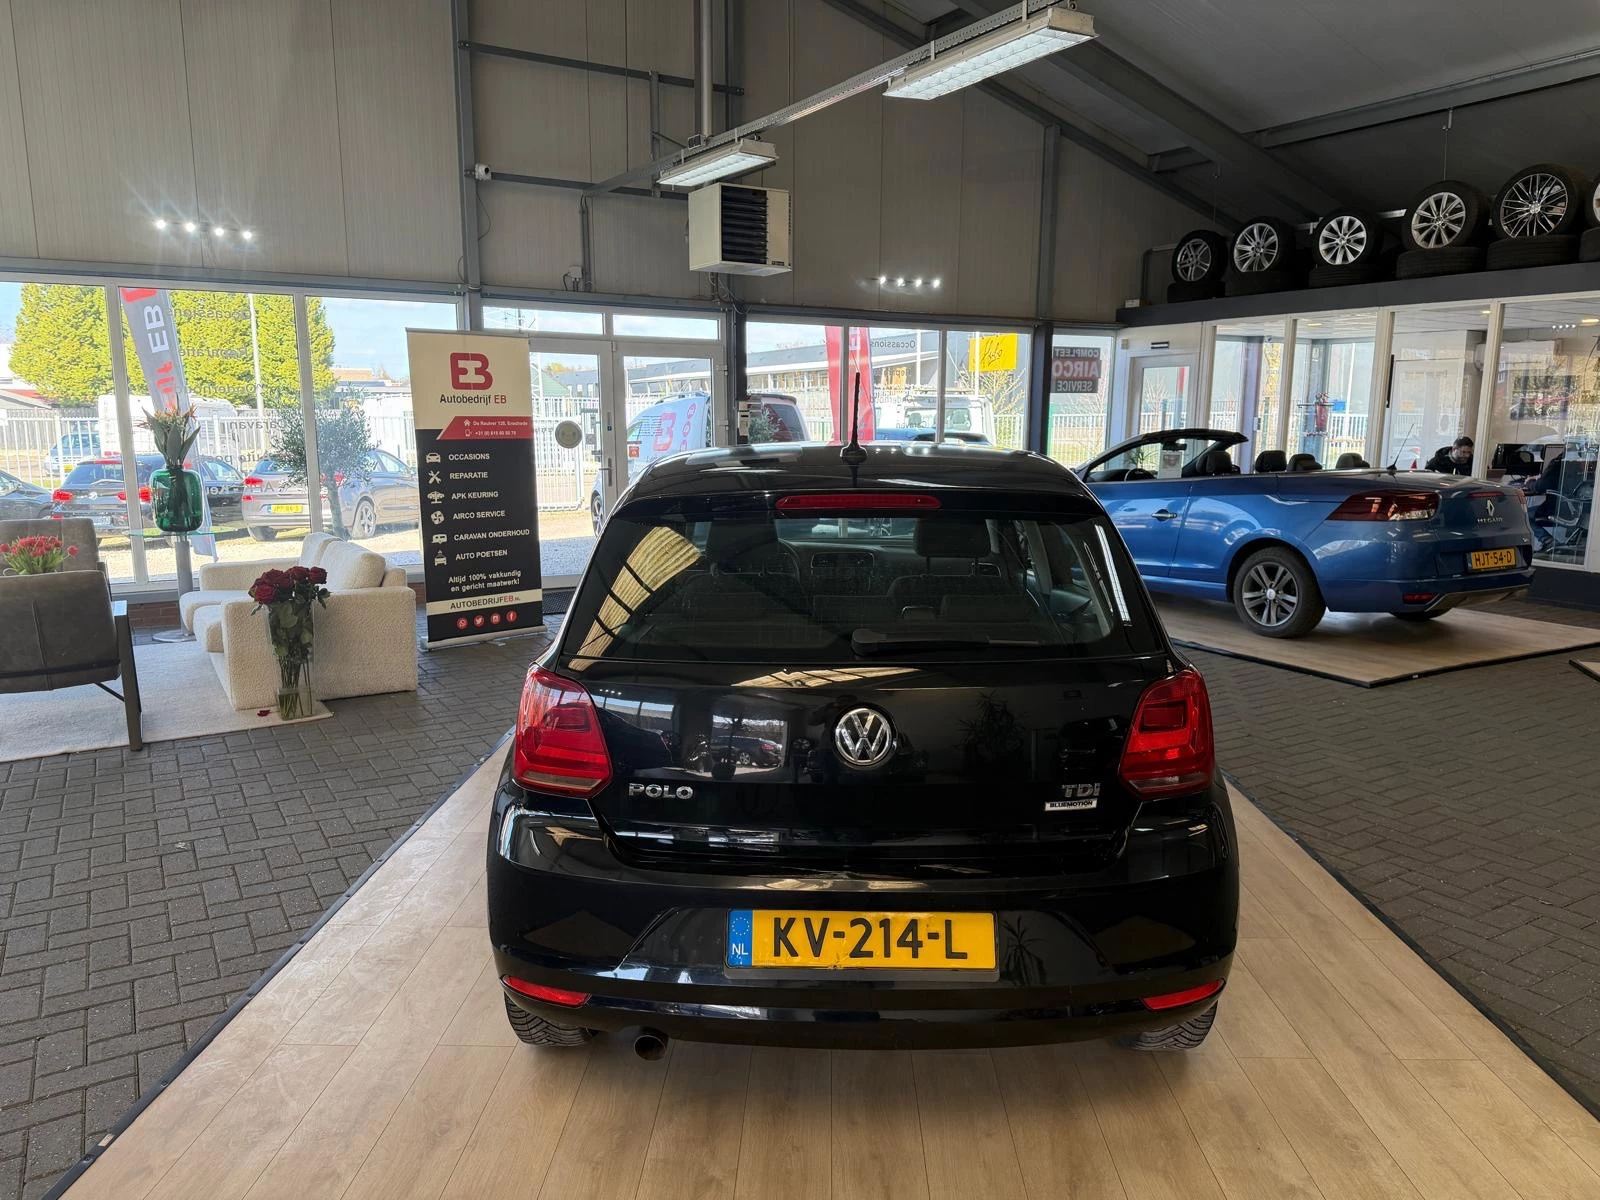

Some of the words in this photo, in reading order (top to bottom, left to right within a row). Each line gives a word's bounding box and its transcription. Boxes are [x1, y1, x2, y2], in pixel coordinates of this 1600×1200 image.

[144, 304, 169, 354] EB
[440, 394, 492, 406] Autobedrijf
[494, 394, 507, 404] EB
[448, 453, 490, 461] OCCASIONS
[449, 472, 488, 480] REPARATIE
[468, 491, 499, 499] KEURING
[453, 511, 475, 520] AIRCO
[476, 510, 505, 518] SERVICE
[454, 532, 487, 541] CARAVAN
[488, 529, 530, 538] ONDERHOUD
[455, 552, 475, 561] AUTO
[476, 549, 508, 558] POETSEN
[1474, 550, 1513, 567] HJT-54-D
[448, 576, 466, 584] Altijd
[468, 573, 487, 582] 100%
[488, 569, 521, 580] vakkundig
[461, 581, 485, 592] gericht
[487, 578, 520, 588] maatwerk!
[628, 782, 694, 800] POLO
[1061, 782, 1101, 798] TDI
[1049, 799, 1094, 808] BLUEMOTION
[773, 917, 968, 960] KV-214-L
[731, 942, 749, 956] NL
